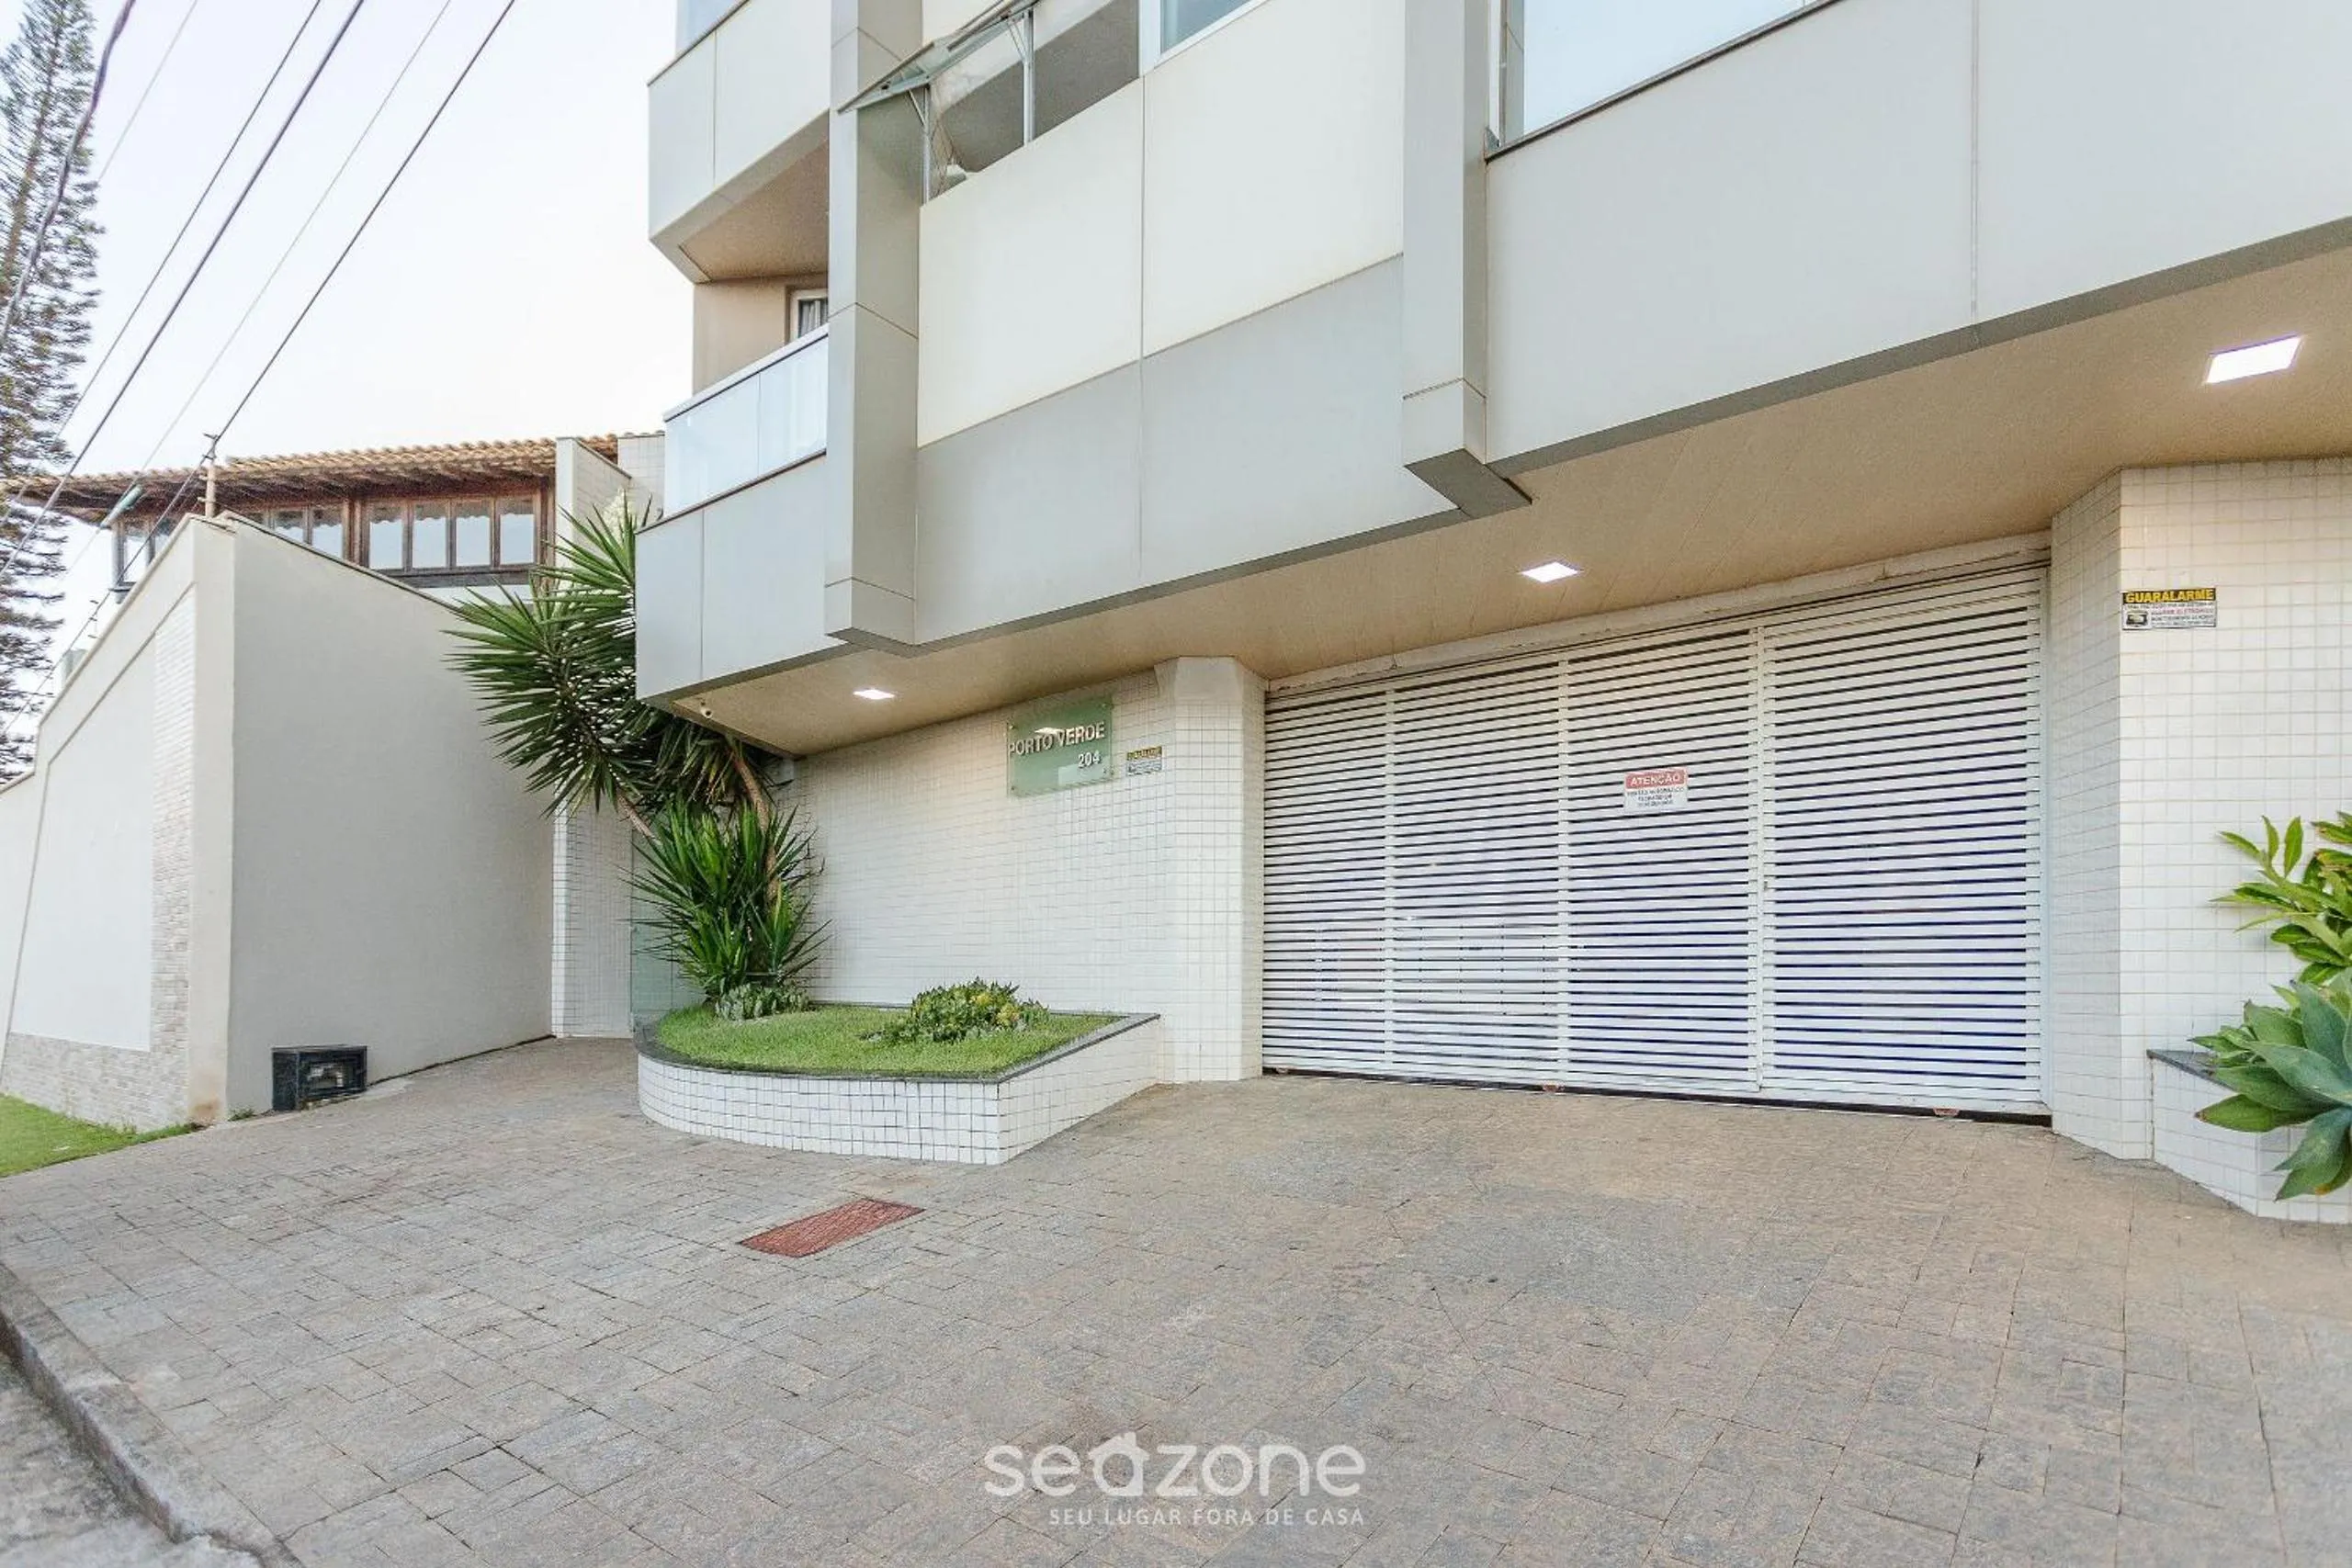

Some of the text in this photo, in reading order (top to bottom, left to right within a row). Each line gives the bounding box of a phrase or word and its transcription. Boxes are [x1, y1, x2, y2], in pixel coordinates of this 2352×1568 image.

[2126, 589, 2214, 604] GUARALARME
[1008, 721, 1105, 758] PORTO VERDE
[1078, 750, 1102, 769] 204
[1630, 772, 1681, 787] ATENÇÃO
